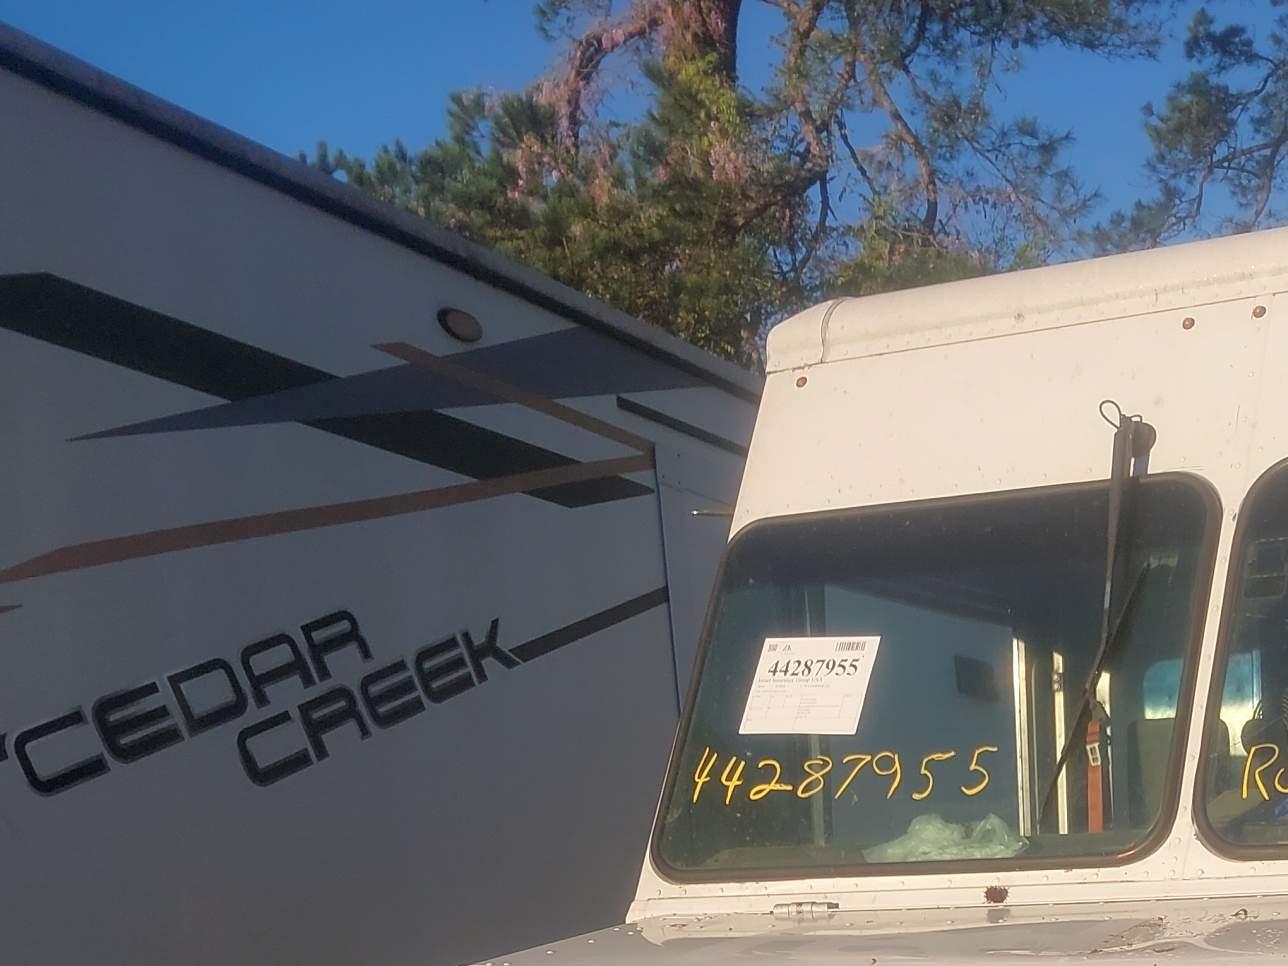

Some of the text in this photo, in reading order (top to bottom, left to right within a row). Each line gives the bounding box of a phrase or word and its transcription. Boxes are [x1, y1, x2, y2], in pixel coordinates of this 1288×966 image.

[13, 609, 374, 797] CEDAR
[236, 616, 523, 788] CREEK
[767, 657, 860, 678] 44287955
[691, 745, 999, 806] 44287955
